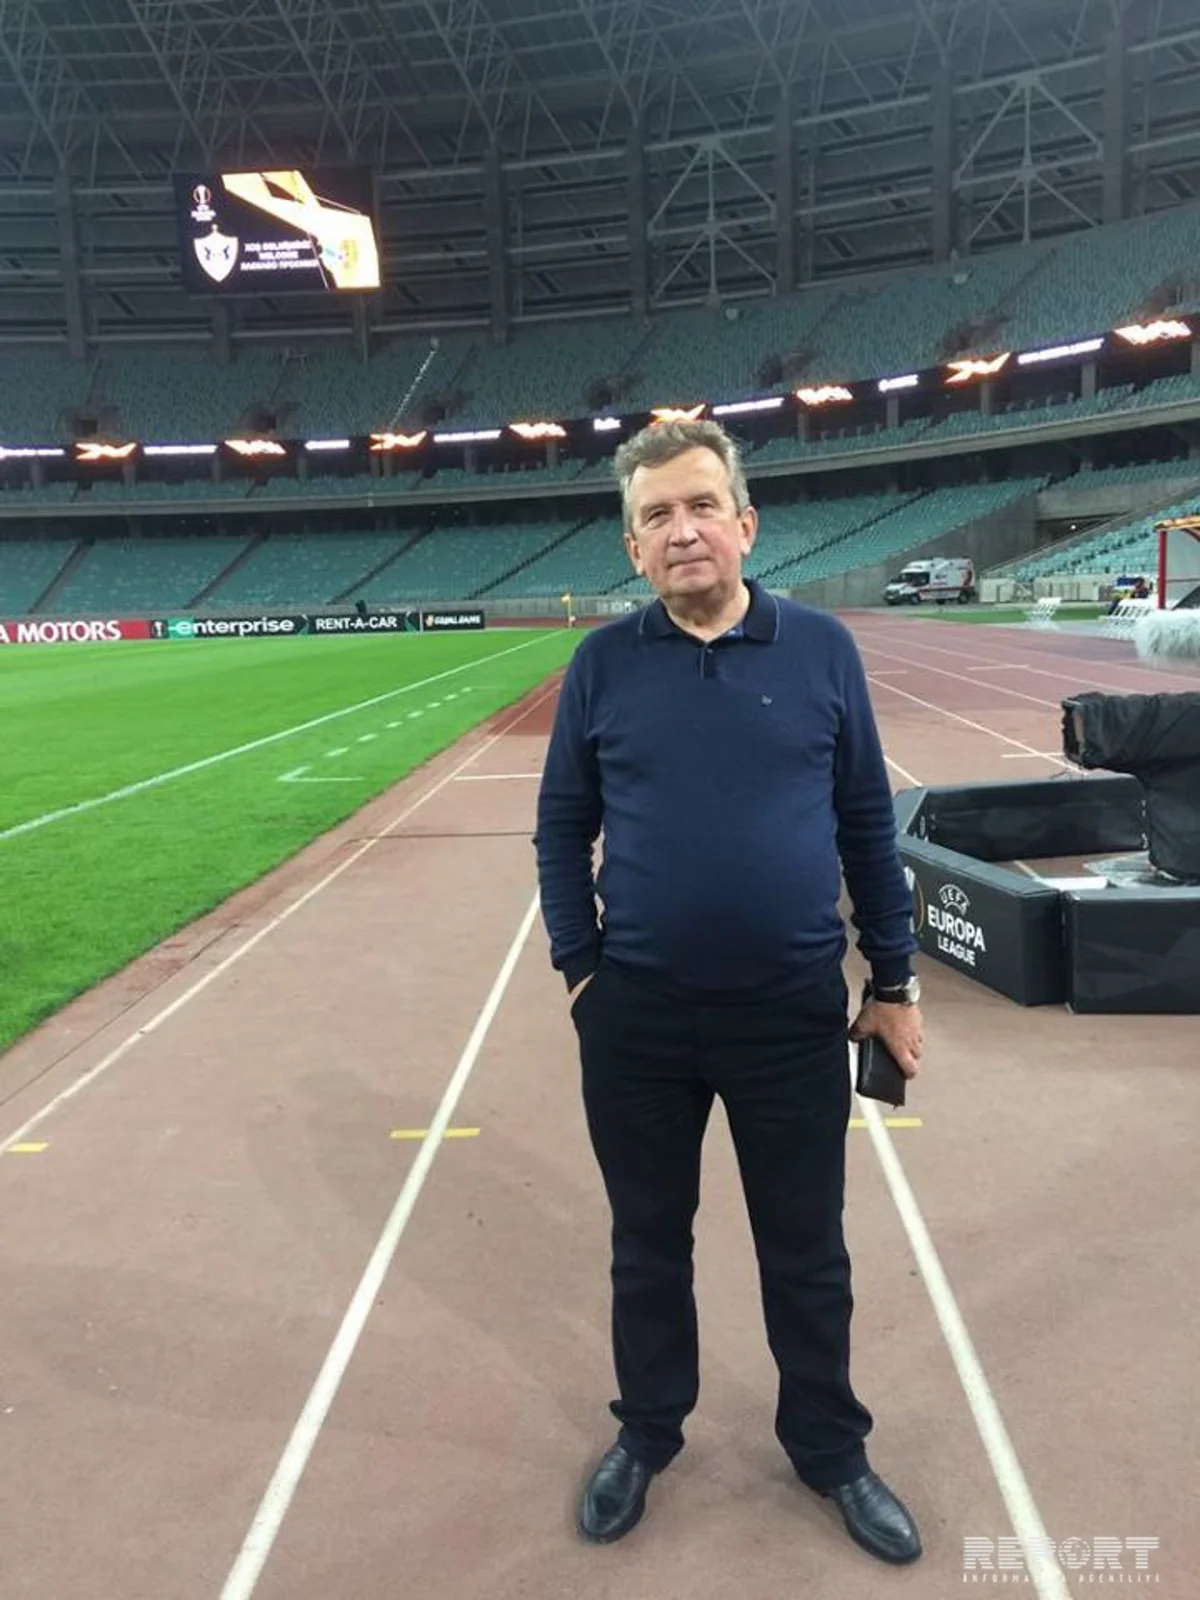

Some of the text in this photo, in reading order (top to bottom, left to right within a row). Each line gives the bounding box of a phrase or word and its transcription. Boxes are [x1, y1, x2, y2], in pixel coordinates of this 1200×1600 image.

[17, 620, 122, 643] MOTORS
[174, 616, 295, 636] enterprise
[315, 616, 398, 631] RENT-A-CAR
[940, 888, 967, 915] UEFA
[927, 904, 987, 952] EUROPA
[937, 934, 976, 967] LEAGUE
